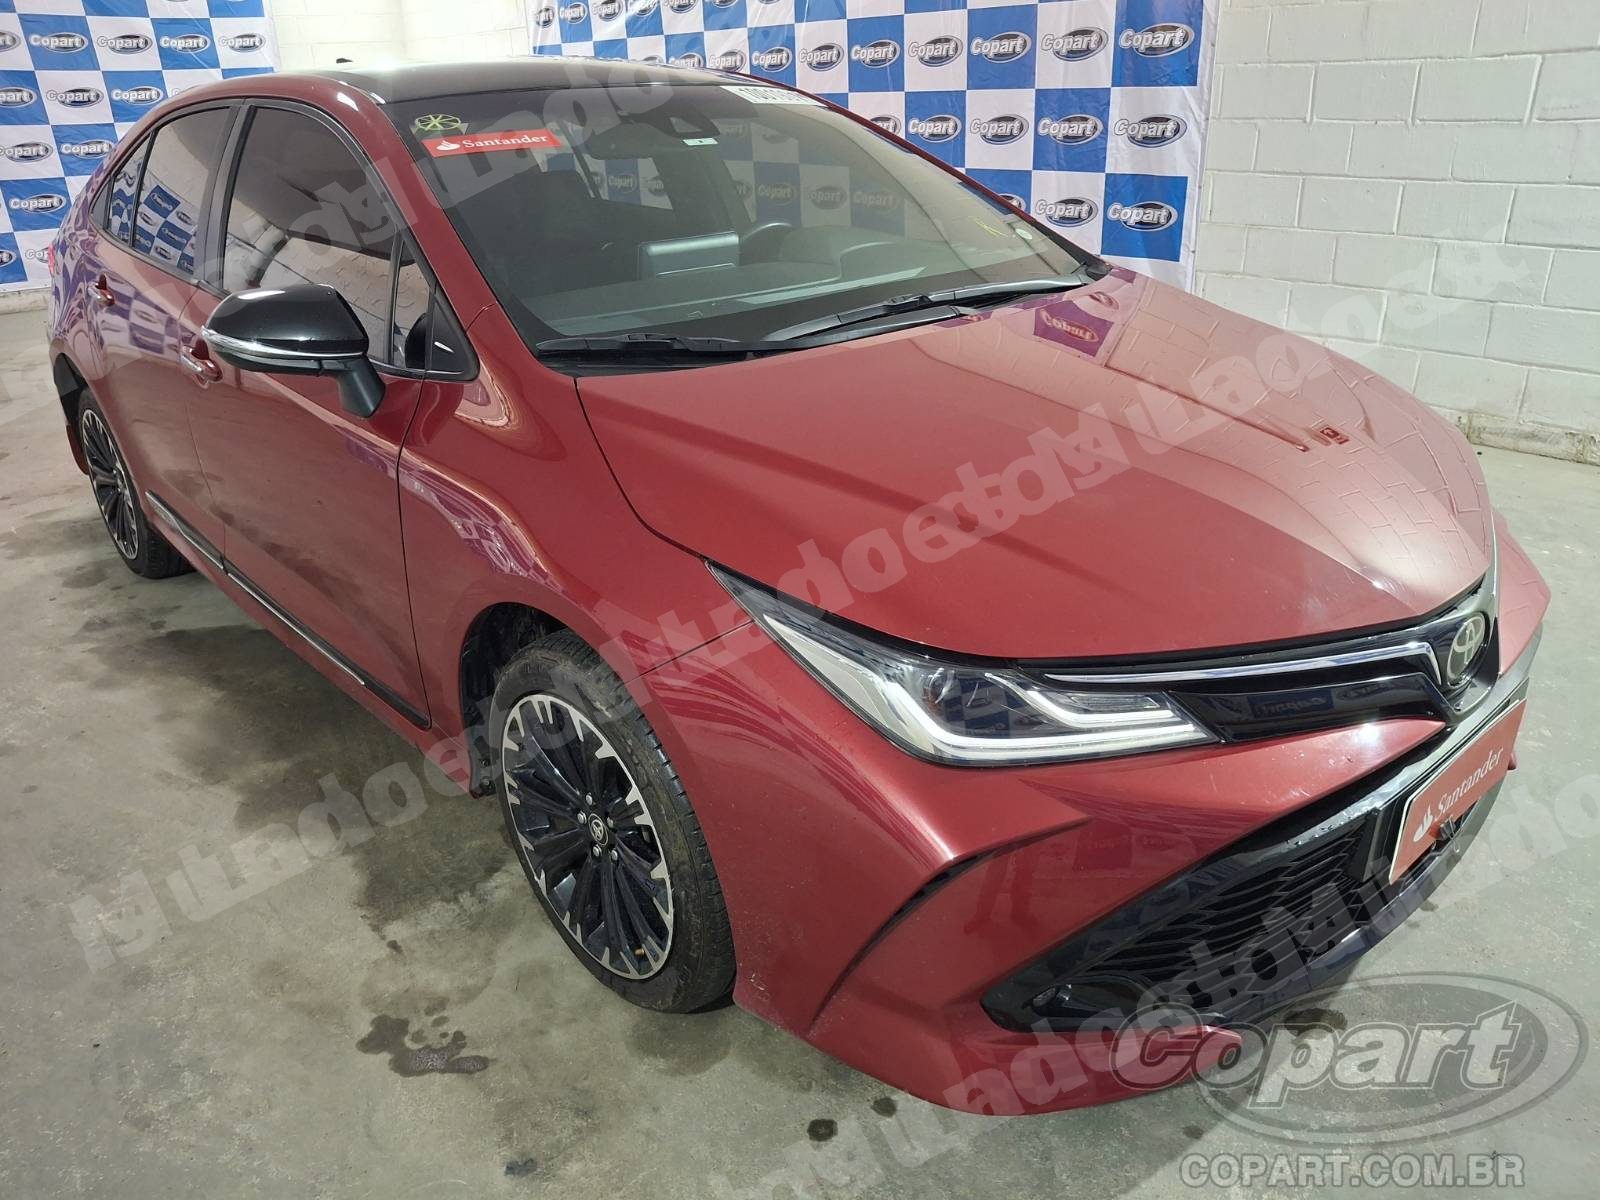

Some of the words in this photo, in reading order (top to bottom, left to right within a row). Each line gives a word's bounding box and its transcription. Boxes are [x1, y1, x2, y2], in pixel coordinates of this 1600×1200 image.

[29, 34, 82, 49] Copart
[97, 36, 146, 49] Copart
[160, 36, 205, 50] Copart
[219, 35, 261, 48] Copart
[909, 37, 955, 60] Copart
[971, 32, 1025, 57] Copart
[1041, 28, 1099, 56] Copart
[1119, 25, 1185, 54] Copart
[752, 50, 787, 67] Copart
[800, 46, 838, 64] Copart
[852, 42, 894, 61] Copart
[46, 89, 98, 104] Copart
[112, 88, 159, 103] Copart
[908, 116, 956, 138] Copart
[970, 114, 1023, 138] Copart
[1037, 116, 1096, 139] Copart
[1113, 117, 1175, 139] Copart
[61, 143, 110, 157] Copart
[462, 133, 549, 149] Santander
[9, 197, 60, 212] Copart
[1035, 199, 1092, 220] Copart
[1107, 202, 1169, 226] Copart
[1434, 746, 1504, 821] Santander
